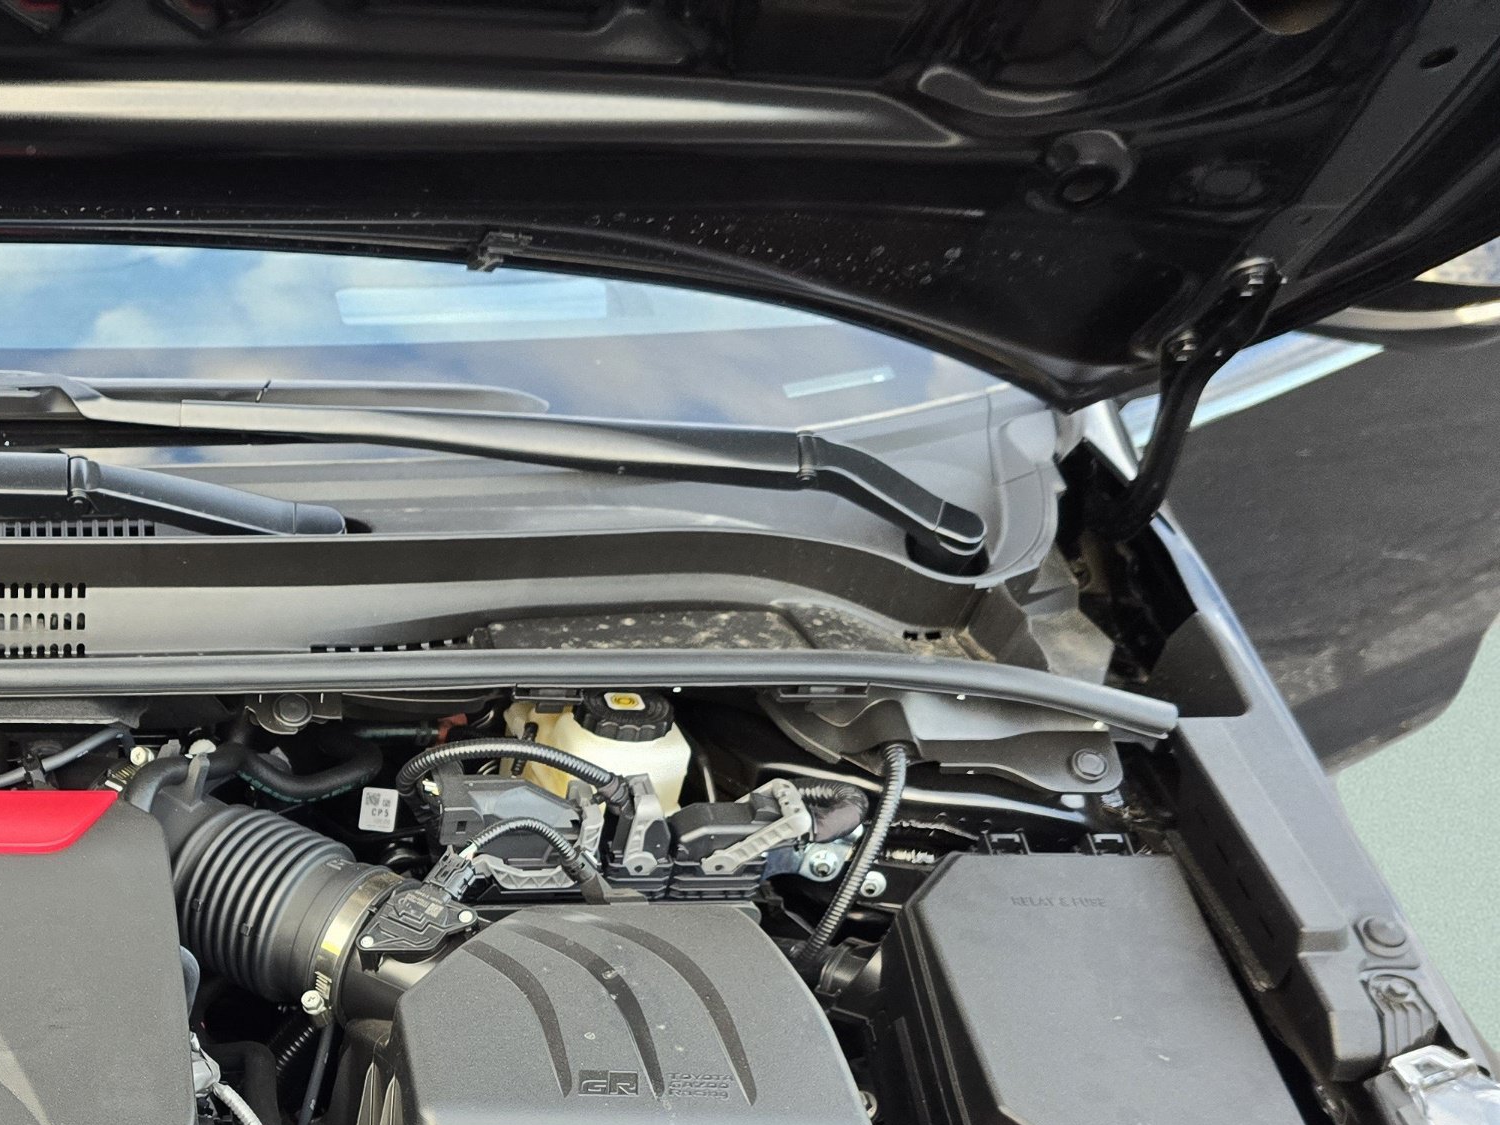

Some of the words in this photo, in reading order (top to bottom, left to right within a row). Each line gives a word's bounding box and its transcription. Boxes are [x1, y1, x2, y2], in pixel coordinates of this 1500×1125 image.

[1010, 896, 1054, 906] RELAY
[1058, 896, 1070, 907] &
[666, 1072, 734, 1082] TOYOTA
[581, 1078, 637, 1095] GR
[668, 1080, 730, 1090] GAZOO
